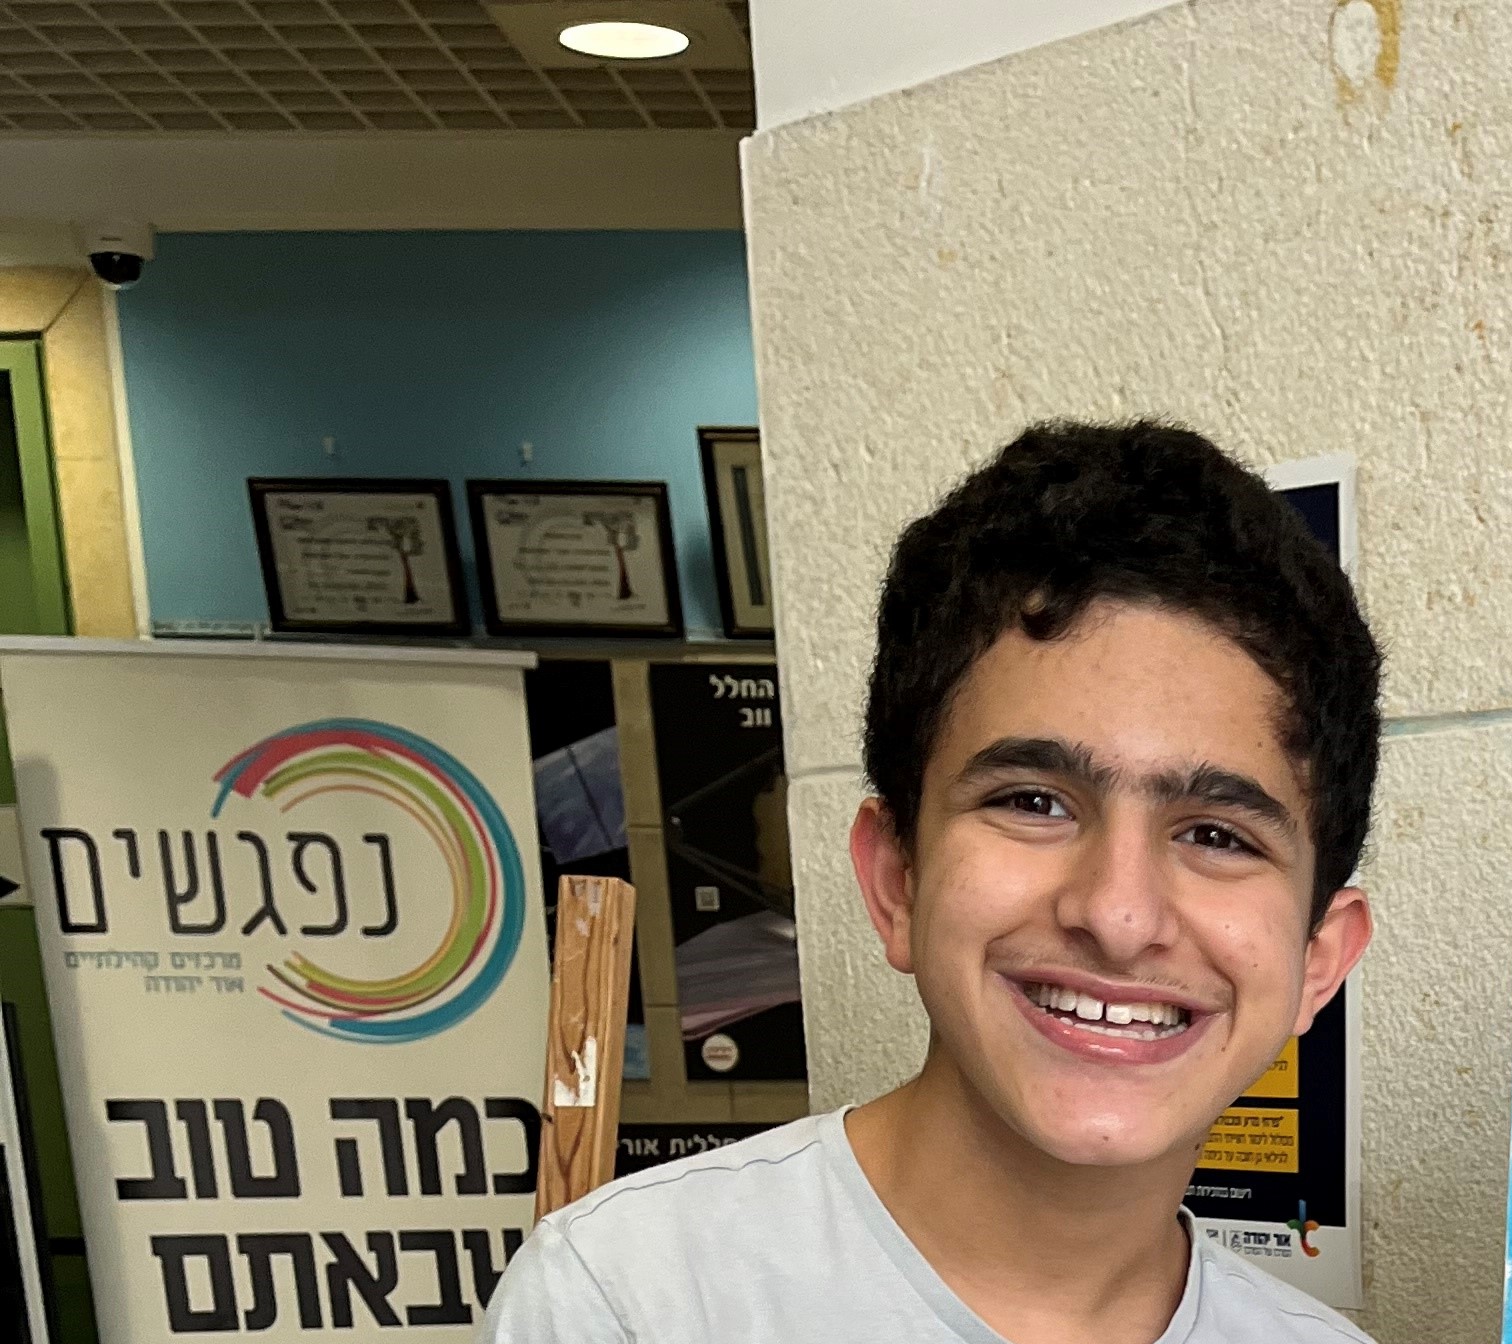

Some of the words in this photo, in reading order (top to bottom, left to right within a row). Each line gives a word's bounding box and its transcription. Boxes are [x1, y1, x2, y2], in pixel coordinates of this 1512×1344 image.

[709, 674, 774, 699] החלל
[737, 707, 772, 728] ווב
[41, 828, 399, 936] נפגשים
[170, 951, 242, 969] מרכזים
[144, 976, 203, 993] יהודה
[209, 976, 245, 993] אור
[107, 1098, 300, 1200] טוב
[330, 1097, 542, 1197] כמה
[619, 1138, 660, 1156] אור
[670, 1134, 737, 1155] ללית
[151, 1229, 523, 1332] שבאתם
